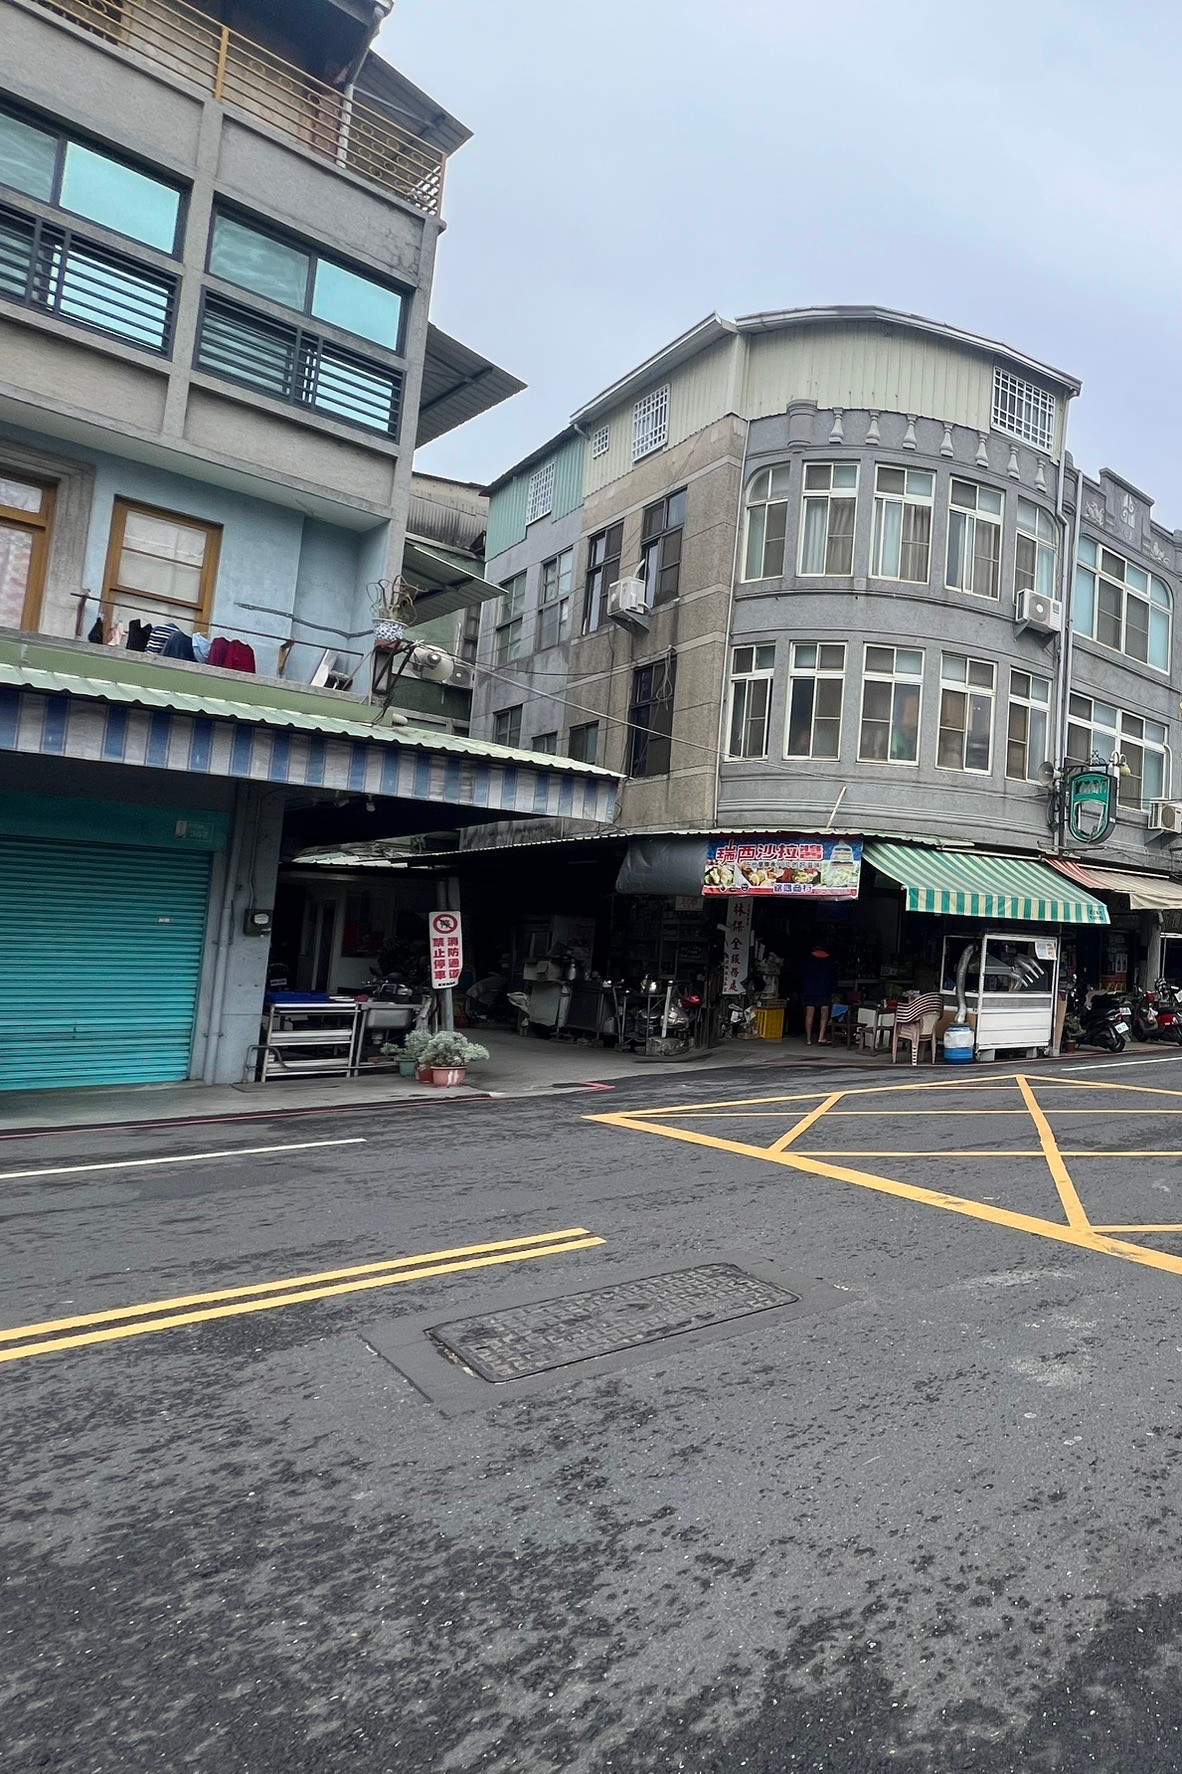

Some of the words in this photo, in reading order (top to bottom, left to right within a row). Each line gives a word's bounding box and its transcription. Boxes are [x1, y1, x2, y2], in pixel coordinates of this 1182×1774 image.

[716, 840, 823, 865] 瑞西沙拉醬
[432, 938, 446, 979] 禁止停車
[447, 937, 460, 979] 消防通道
